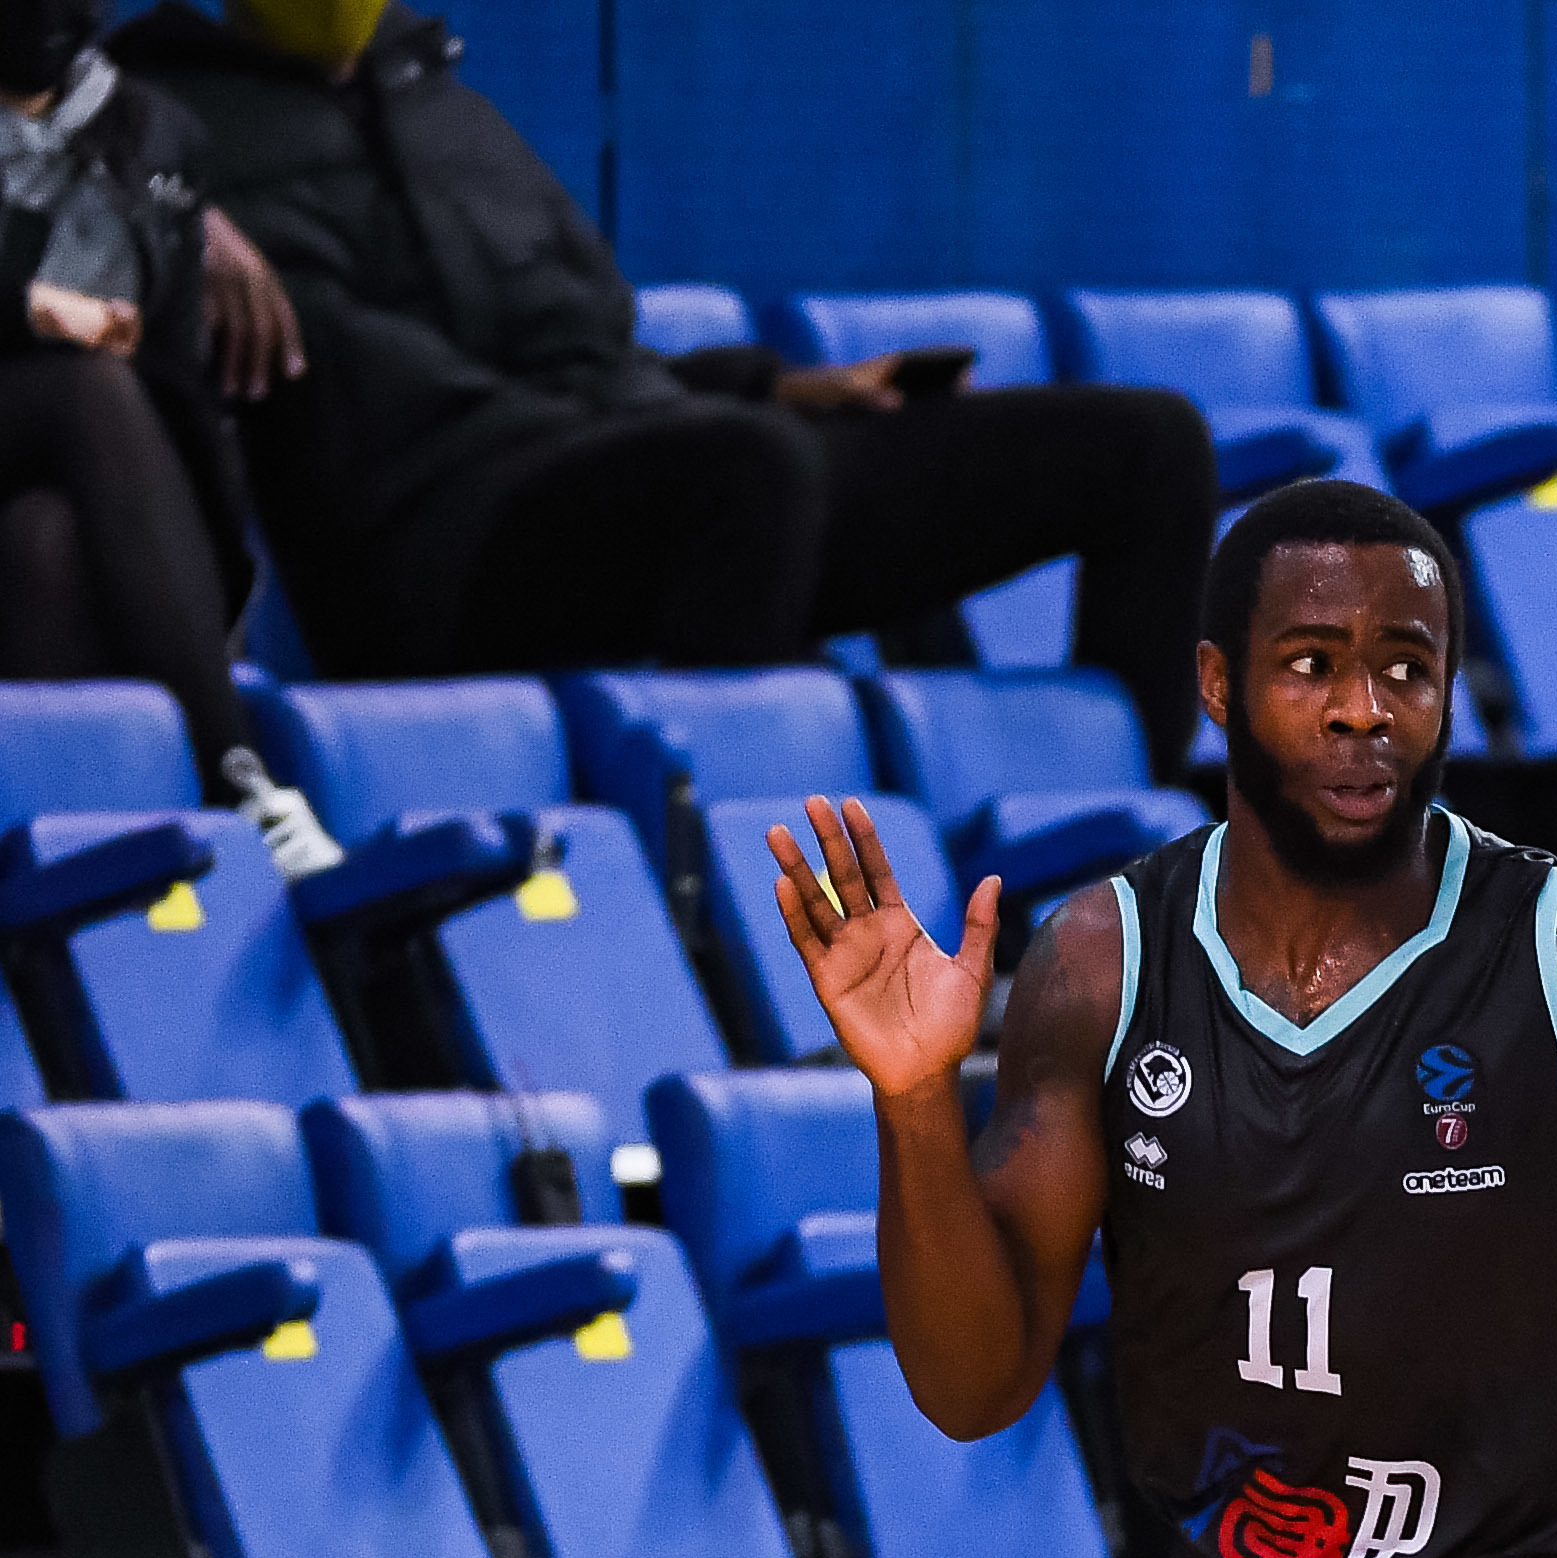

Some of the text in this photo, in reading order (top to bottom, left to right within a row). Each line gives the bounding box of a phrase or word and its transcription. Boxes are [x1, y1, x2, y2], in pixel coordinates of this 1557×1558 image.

[1423, 1101, 1476, 1115] EuroCup
[1441, 1118, 1457, 1144] 7
[1404, 1166, 1504, 1193] oneteam
[1238, 1267, 1342, 1396] 11
